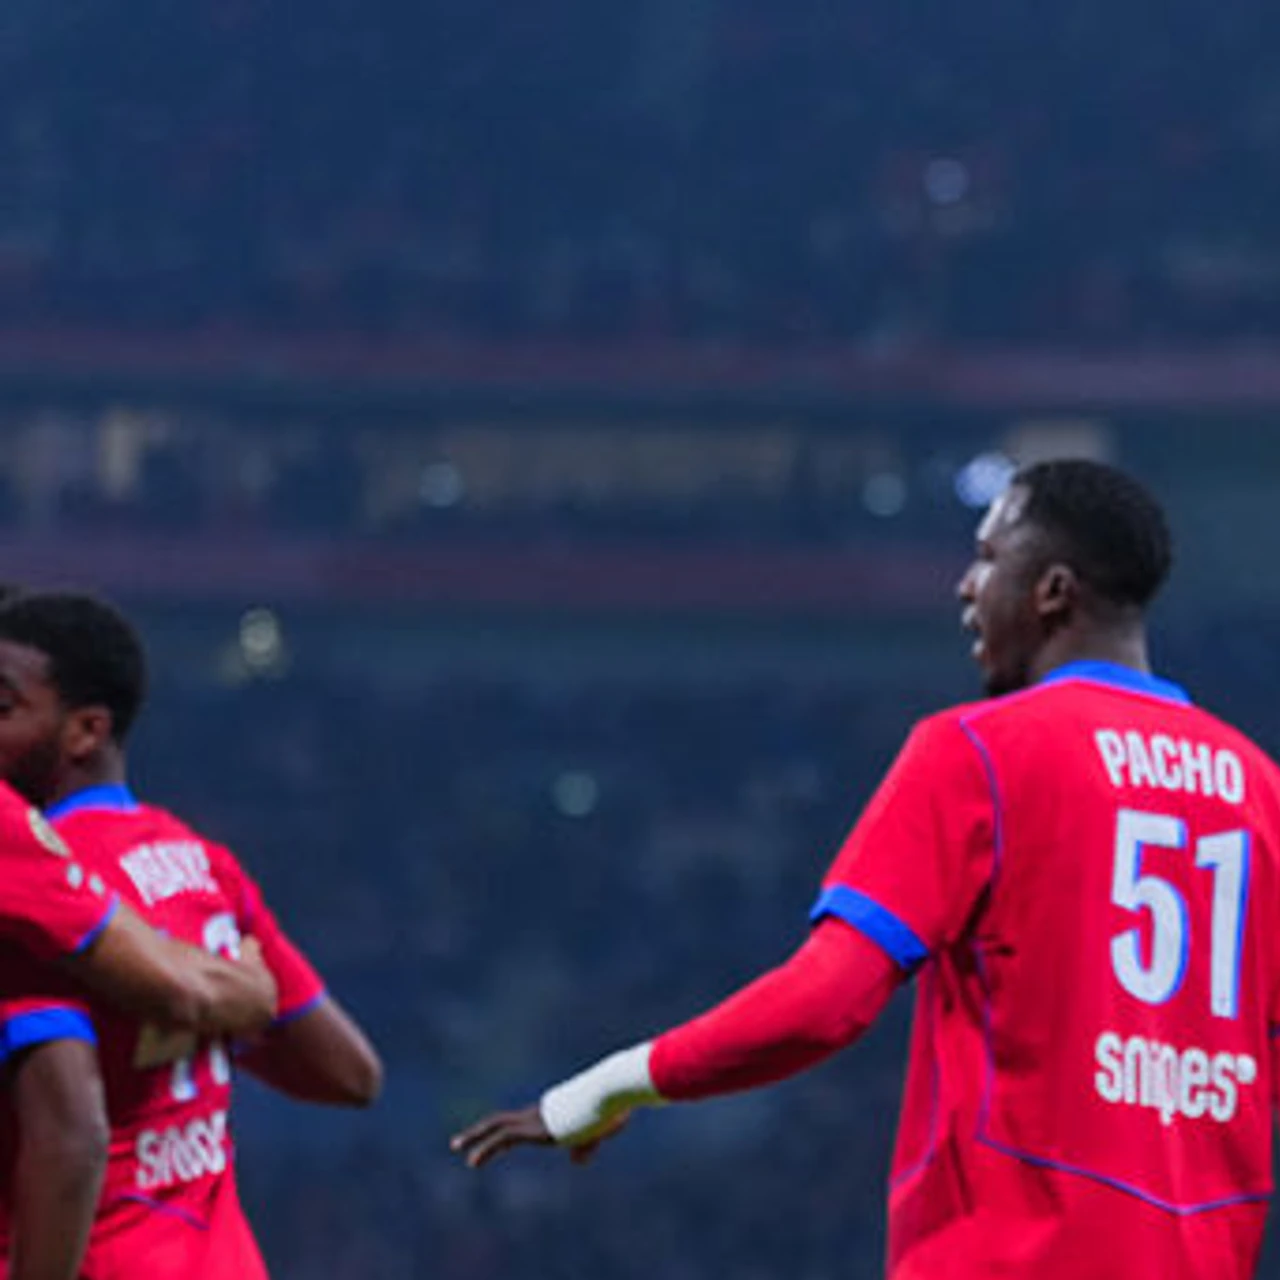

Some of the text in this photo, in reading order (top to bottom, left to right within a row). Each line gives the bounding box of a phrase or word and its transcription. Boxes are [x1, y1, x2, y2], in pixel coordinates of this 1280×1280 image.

[1094, 729, 1245, 804] PACHO
[1110, 808, 1250, 1020] 51
[1094, 1032, 1240, 1125] snipes
